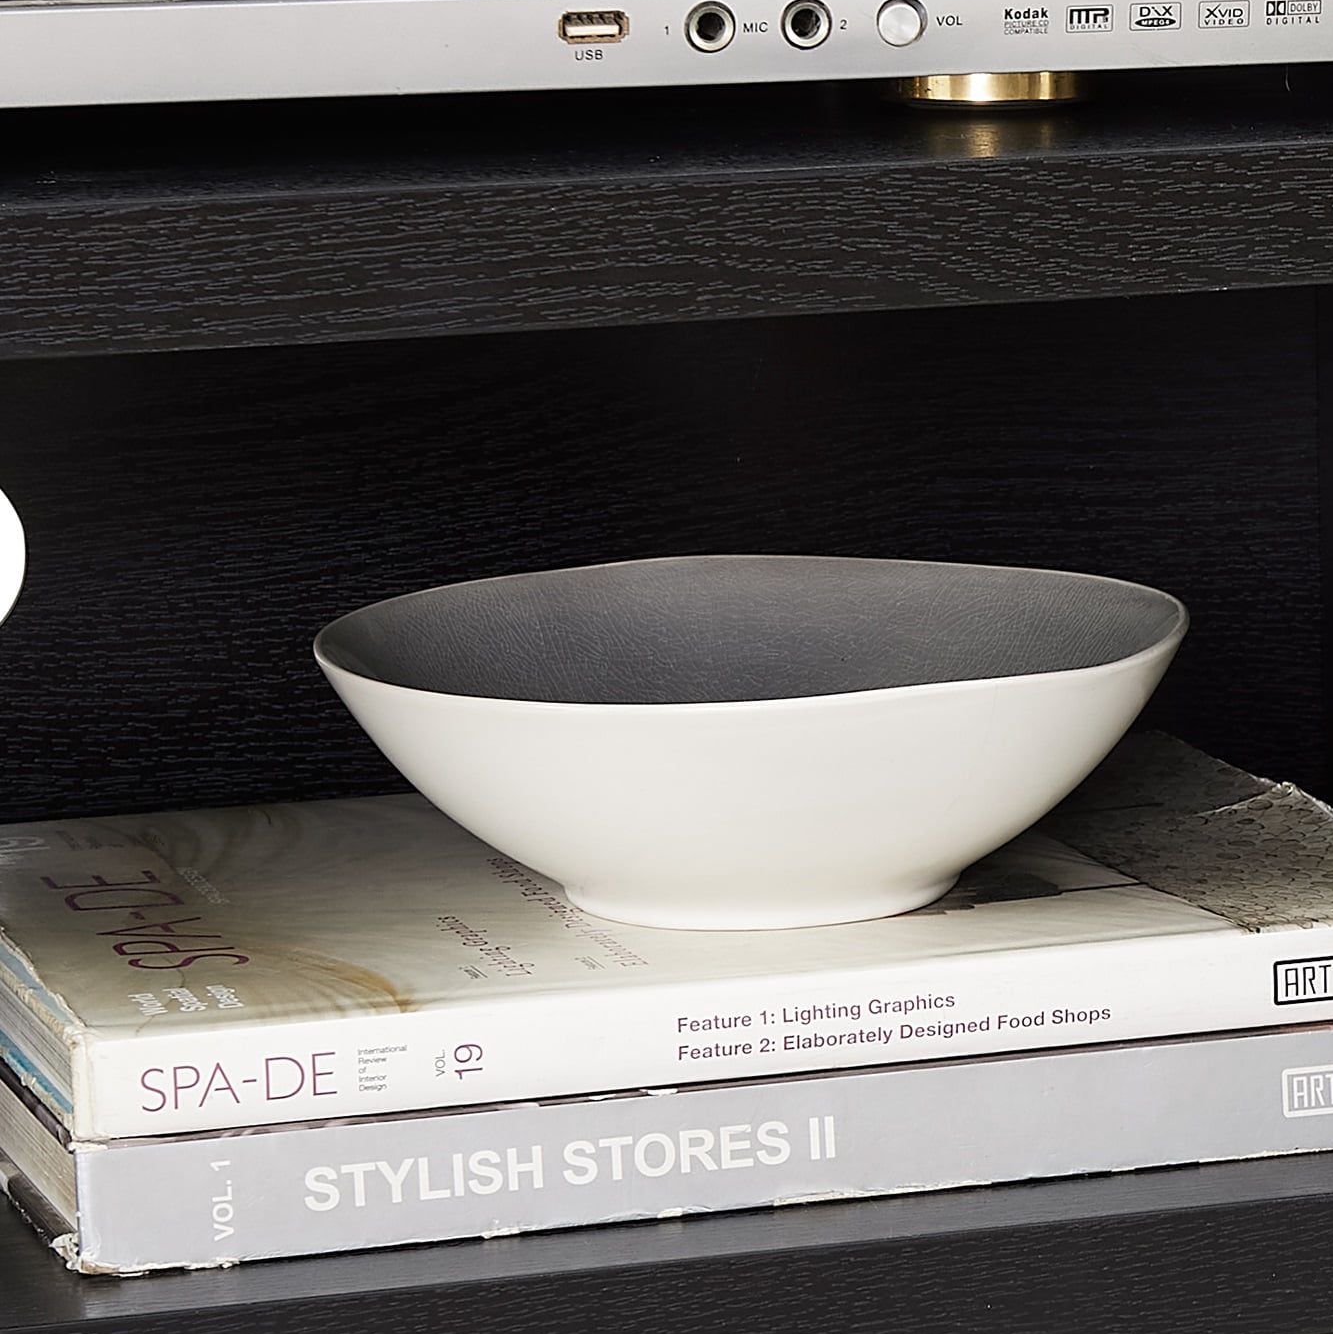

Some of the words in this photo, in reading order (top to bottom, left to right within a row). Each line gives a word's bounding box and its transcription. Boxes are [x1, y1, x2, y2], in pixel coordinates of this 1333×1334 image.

[1290, 2, 1318, 13] DOLBY
[1004, 7, 1049, 20] Kodak
[936, 15, 963, 28] VOL
[1004, 20, 1038, 28] PICTURE
[1039, 19, 1049, 27] CD
[1204, 18, 1244, 26] VIDEO
[1266, 16, 1320, 26] DIGITAL
[664, 26, 670, 36] 1
[743, 21, 769, 34] MIC
[840, 19, 848, 30] 2
[1004, 27, 1048, 35] COMPATIBLE
[574, 50, 604, 61] USB
[677, 1014, 752, 1034] Feature
[760, 1010, 776, 1025] 1:
[782, 1003, 862, 1025] Lighting
[868, 993, 956, 1015] Graphics
[677, 1042, 753, 1061] Feature
[759, 1037, 776, 1053] 2:
[783, 1026, 894, 1050] Elaborately
[900, 1016, 990, 1039] Designed
[997, 1010, 1046, 1030] Food
[1052, 1007, 1112, 1025] Shops
[358, 1044, 408, 1056] International
[358, 1056, 387, 1065] Review
[454, 1043, 483, 1080] 19
[358, 1066, 367, 1074] of
[140, 1050, 339, 1113] SPA-DE
[358, 1074, 387, 1083] Interior
[358, 1083, 388, 1092] Design
[303, 1144, 545, 1213] STYLISH
[562, 1120, 793, 1185] STORES
[810, 1115, 837, 1160] II
